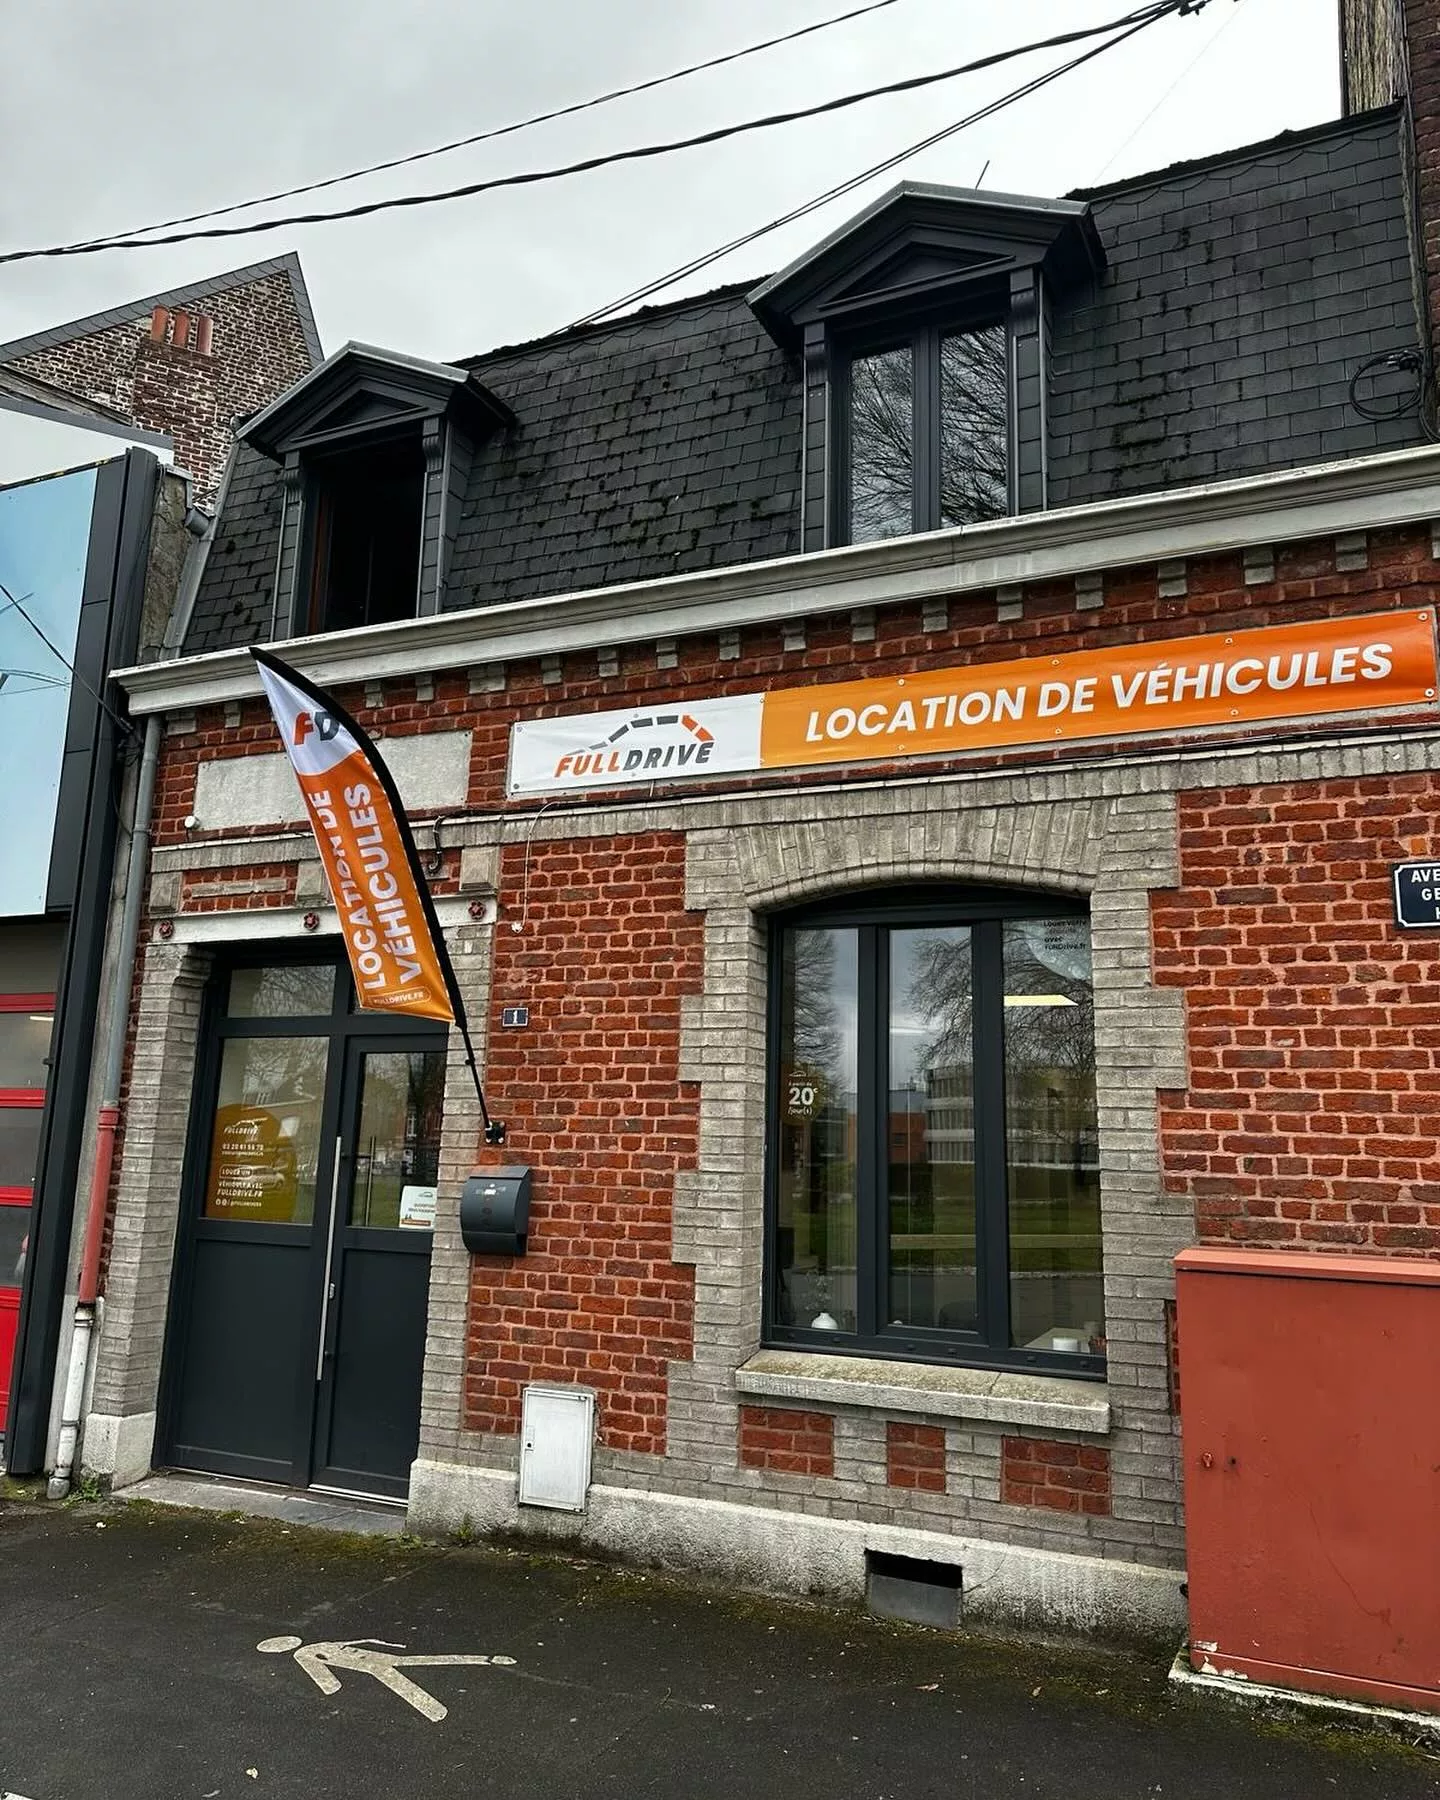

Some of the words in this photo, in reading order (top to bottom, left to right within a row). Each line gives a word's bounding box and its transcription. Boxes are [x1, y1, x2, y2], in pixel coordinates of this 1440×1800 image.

[806, 686, 1026, 742] LOCATION
[1037, 676, 1099, 717] DE
[1111, 643, 1393, 708] VÉHICULES
[554, 741, 715, 778] FULLDRIVE
[308, 789, 338, 829] DE
[343, 783, 423, 985] VÉHICULES
[512, 1010, 518, 1024] 1
